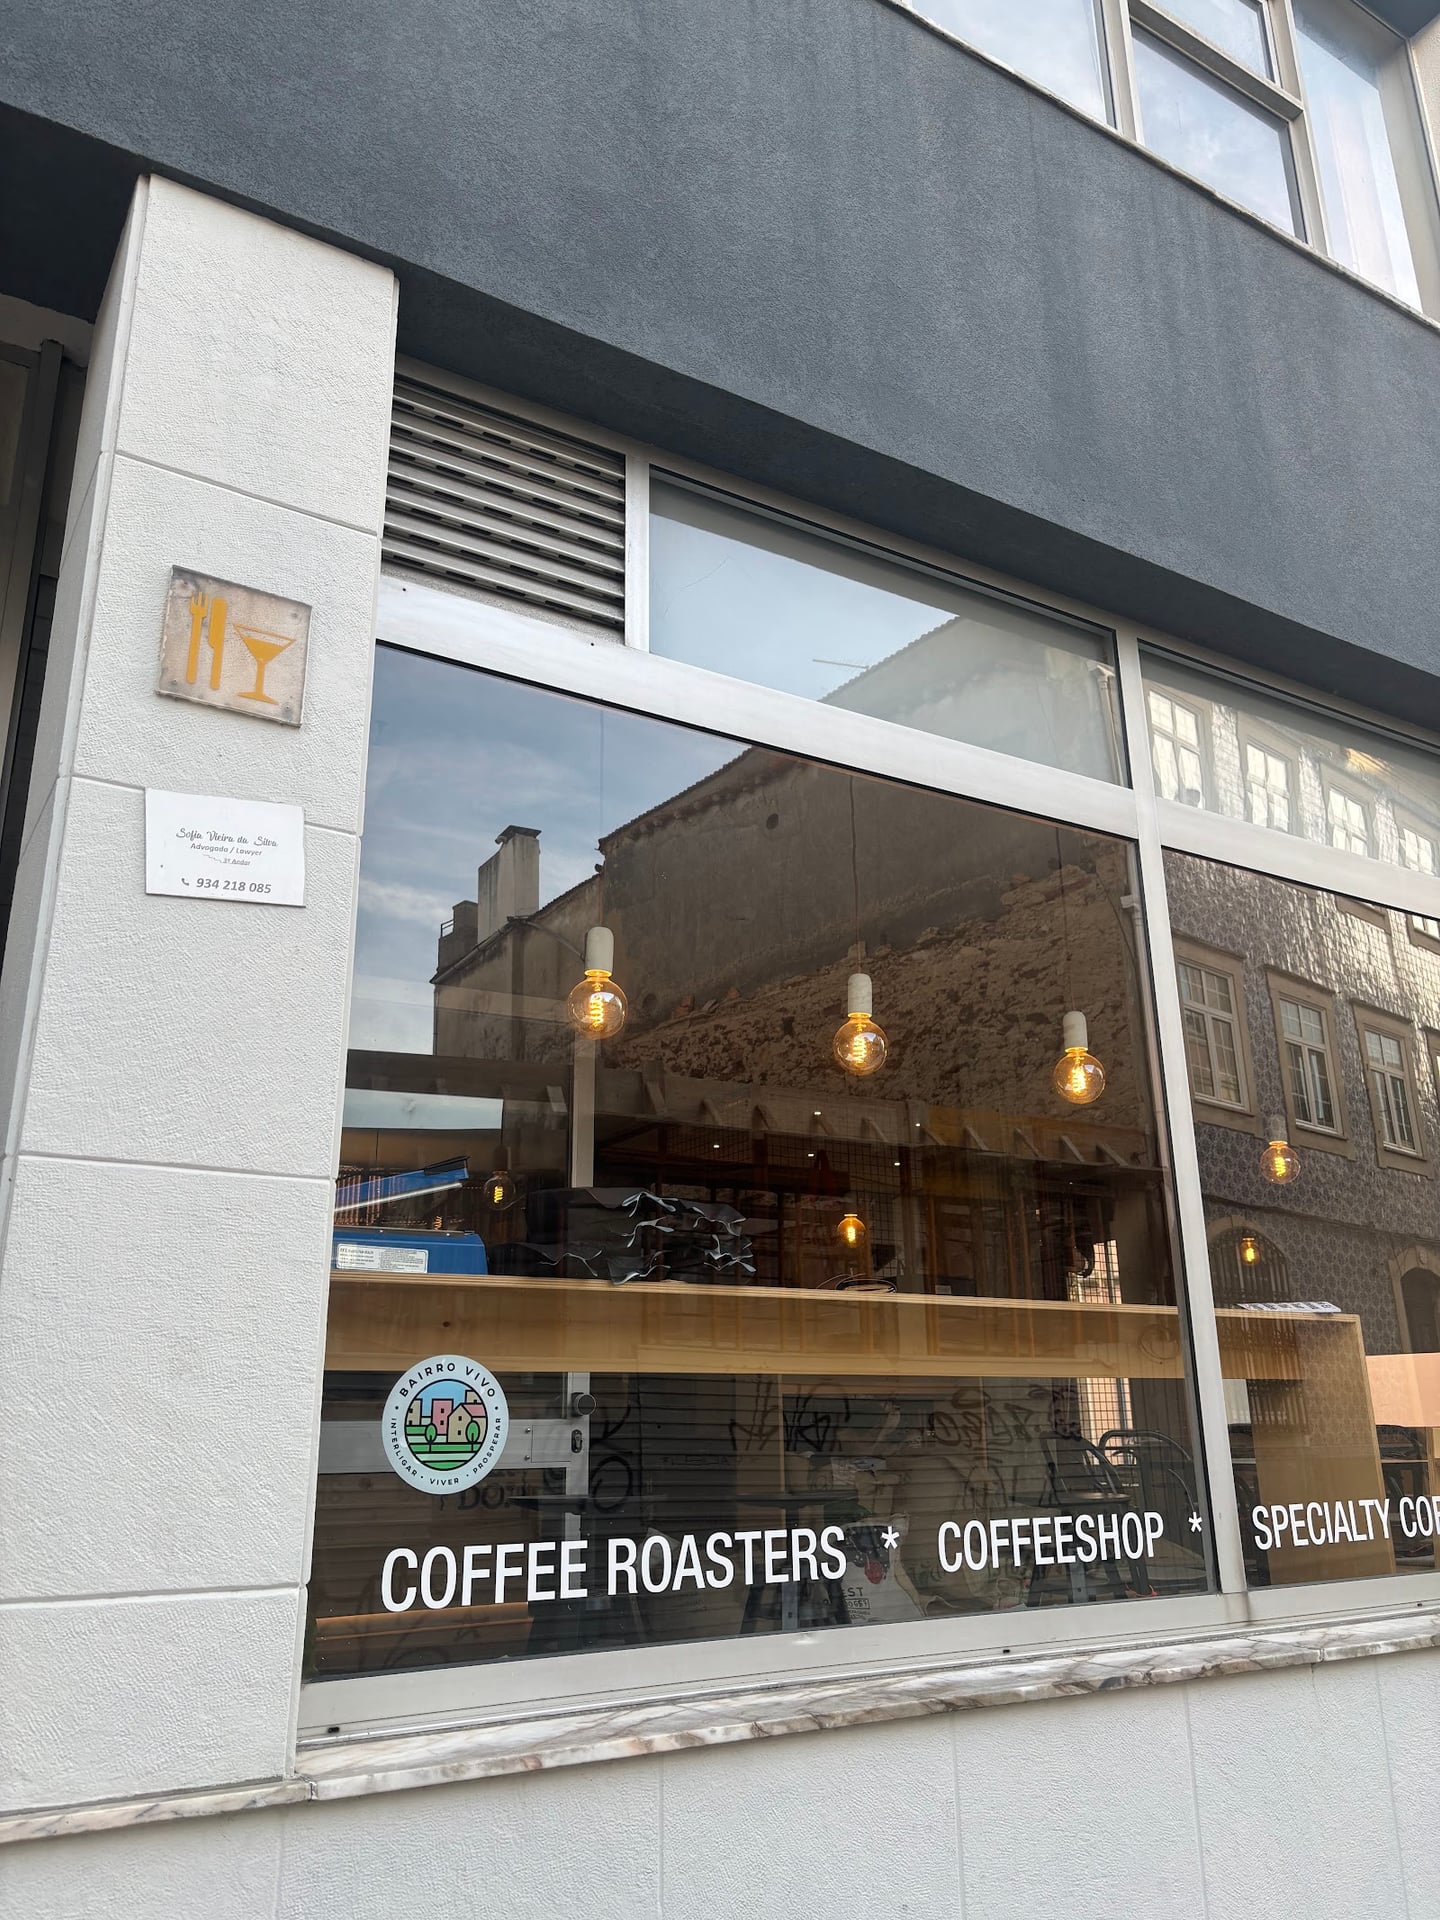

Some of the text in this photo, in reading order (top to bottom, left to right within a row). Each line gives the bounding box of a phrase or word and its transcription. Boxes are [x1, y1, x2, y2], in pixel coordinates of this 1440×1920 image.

[176, 828, 279, 848] Sofia Vieira da Silva
[236, 847, 263, 857] Lawyer
[196, 877, 272, 894] 934 218 085
[399, 1362, 496, 1398] BAIRRO VIVO
[390, 1417, 501, 1486] INTERLIGAR VIVER PROSPERAR
[938, 1511, 1164, 1573] COFFEESHOP
[1253, 1498, 1390, 1550] SPECIALTY
[382, 1525, 847, 1612] COFFEE ROASTERS
